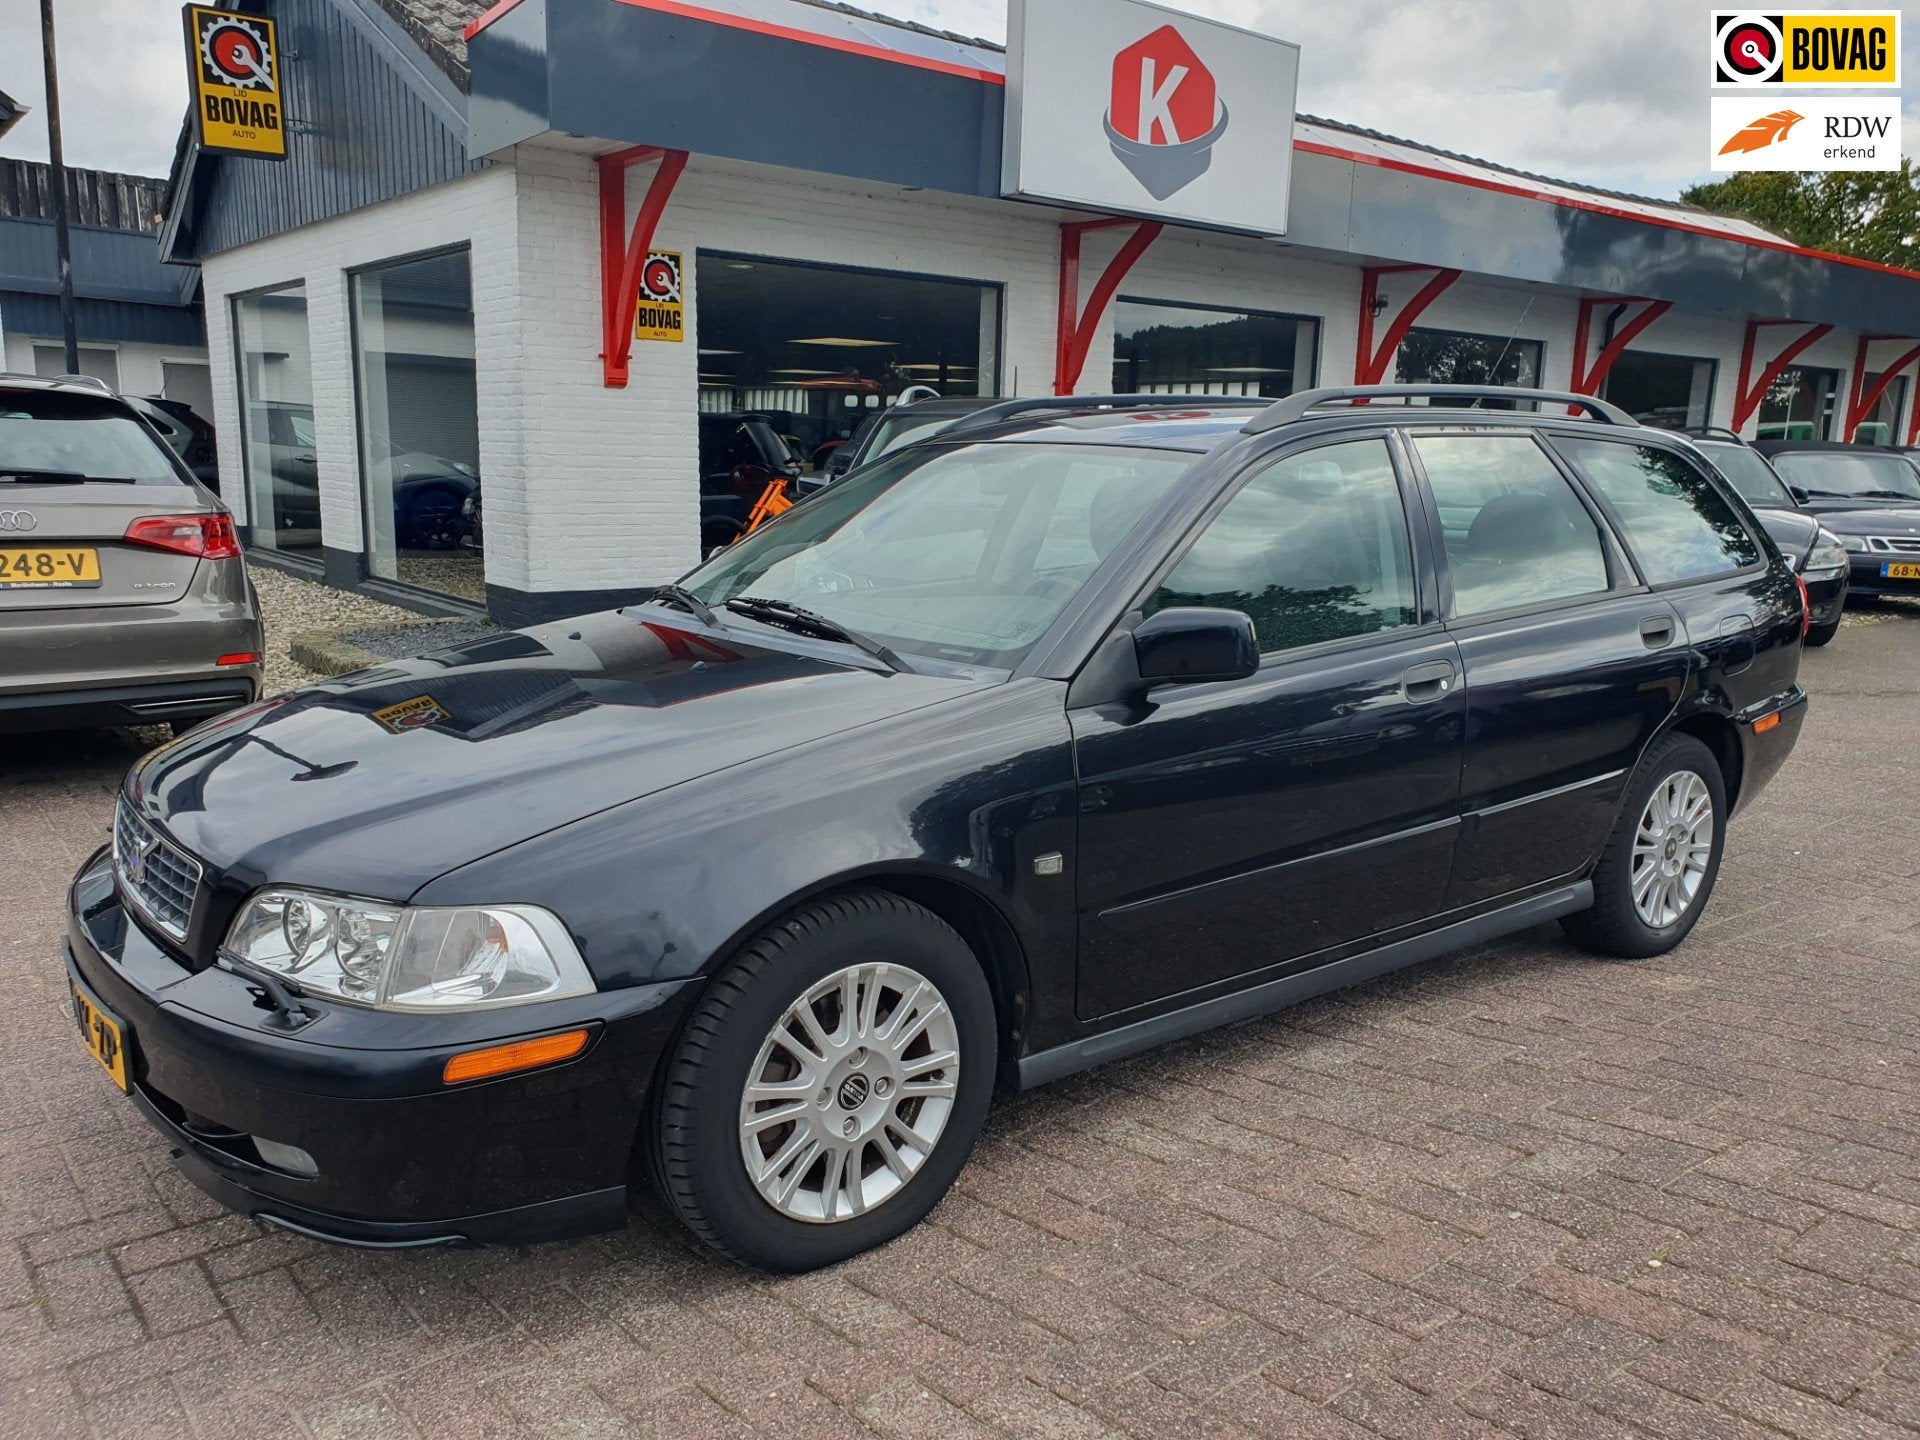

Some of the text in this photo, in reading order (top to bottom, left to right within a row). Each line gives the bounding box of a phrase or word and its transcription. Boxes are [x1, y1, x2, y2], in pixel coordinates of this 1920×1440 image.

[233, 88, 248, 98] LID
[1138, 57, 1189, 145] K
[205, 94, 279, 131] BOVAG
[232, 129, 256, 139] AUTO
[638, 307, 681, 330] BOVAG
